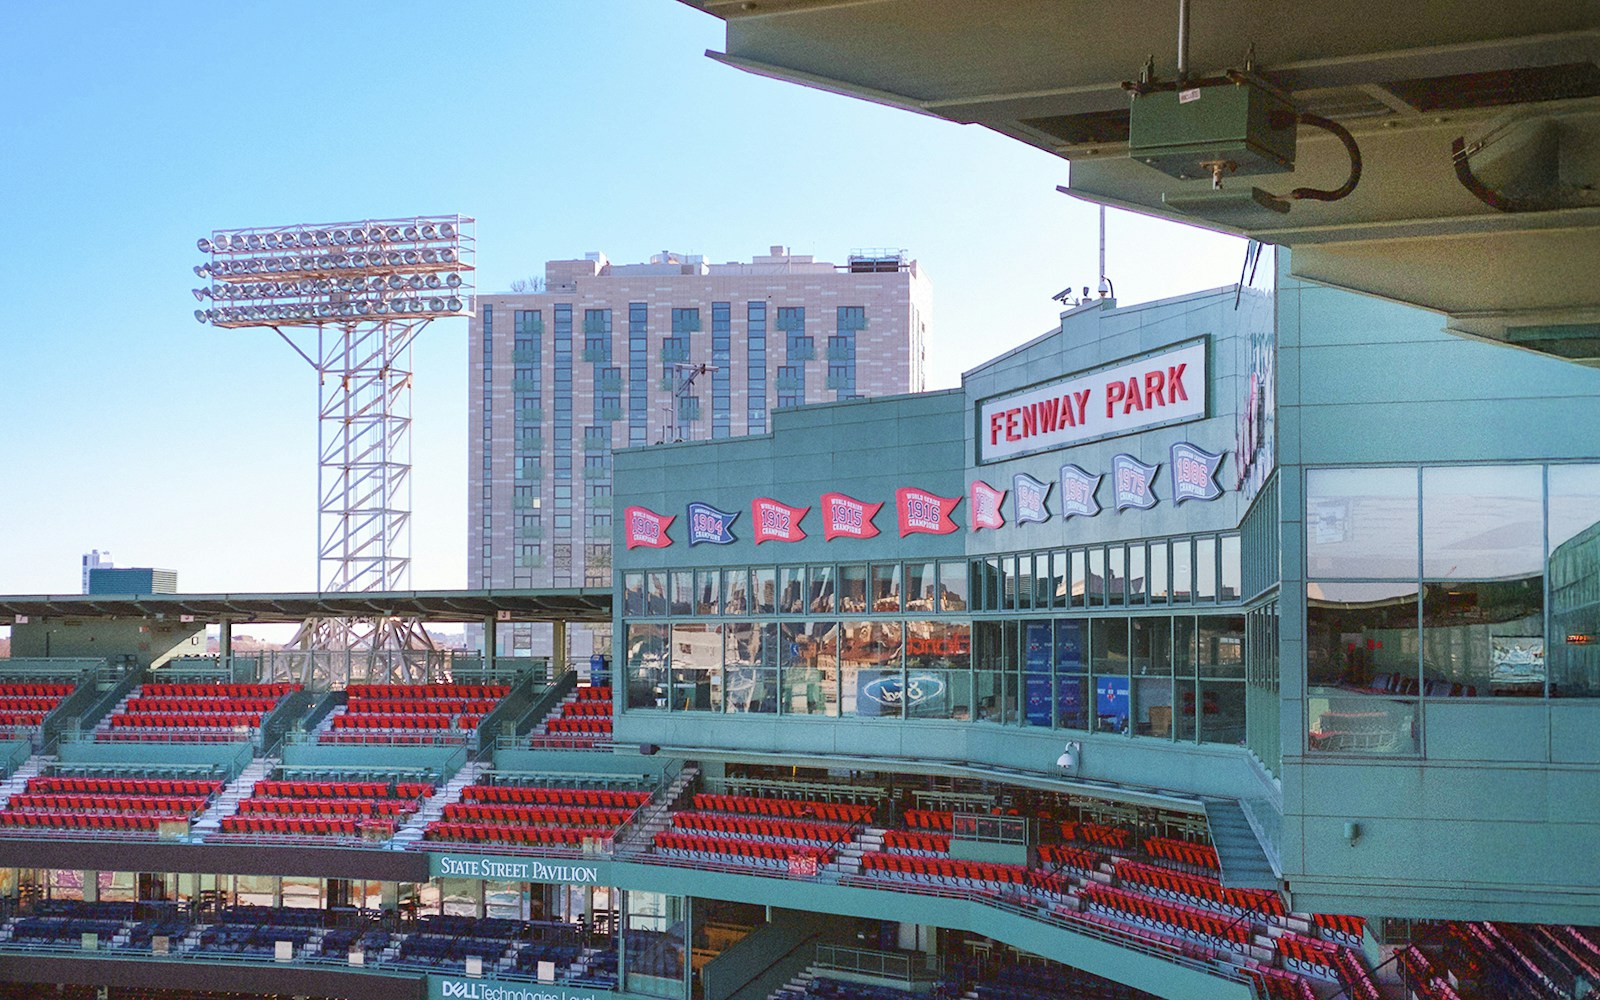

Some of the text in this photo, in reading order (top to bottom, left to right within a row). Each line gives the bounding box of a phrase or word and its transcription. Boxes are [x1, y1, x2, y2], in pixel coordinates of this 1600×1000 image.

[990, 363, 1189, 446] FENWAY PARK
[1118, 468, 1145, 496] 1975
[1178, 457, 1207, 488] 1986
[761, 509, 790, 532] 1912
[832, 505, 863, 528] 1915
[907, 500, 940, 523] 1916
[632, 517, 660, 538] 1903
[694, 513, 723, 537] 1904
[441, 856, 479, 875] STATE
[532, 861, 598, 882] PAVILION
[442, 980, 480, 999] DELL
